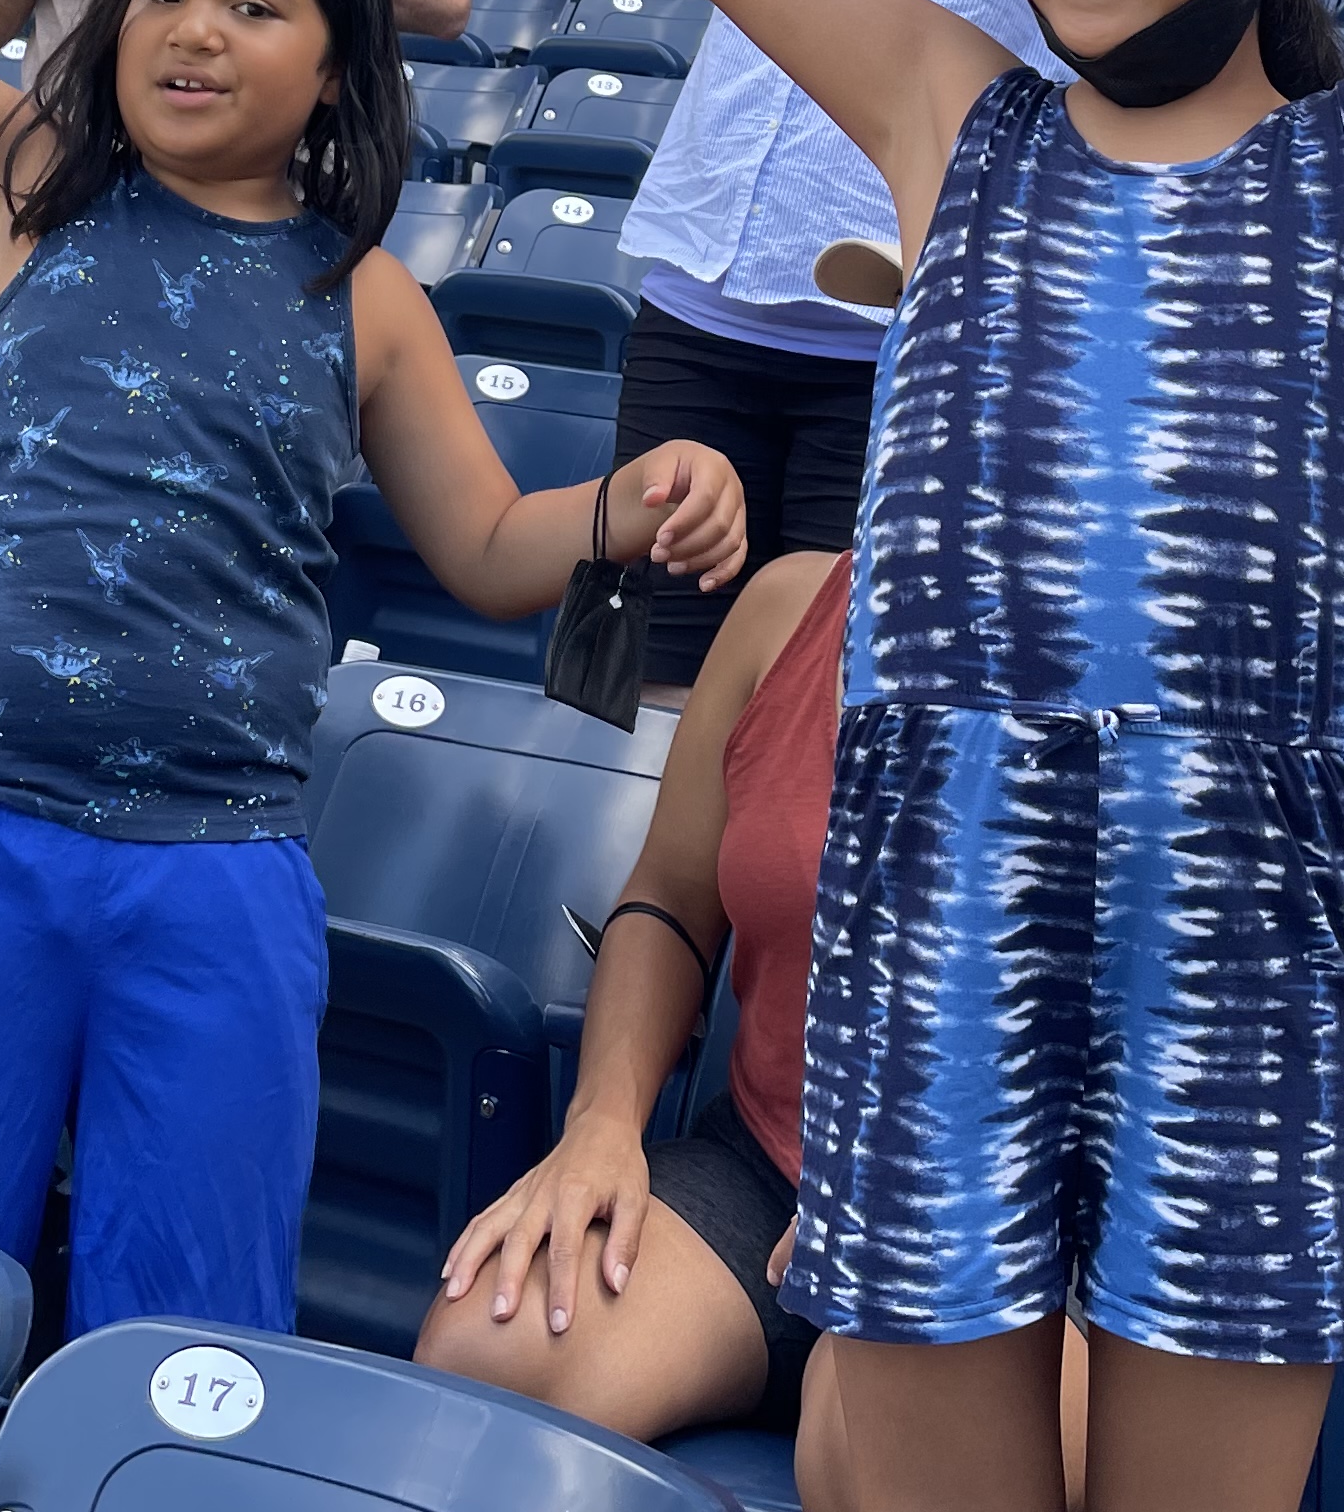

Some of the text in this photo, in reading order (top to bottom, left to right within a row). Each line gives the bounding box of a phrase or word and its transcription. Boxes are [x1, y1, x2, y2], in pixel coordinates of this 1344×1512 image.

[597, 80, 614, 91] 13
[562, 204, 584, 218] 14
[489, 374, 515, 390] 15
[391, 689, 427, 713] 16
[177, 1372, 239, 1413] 17
